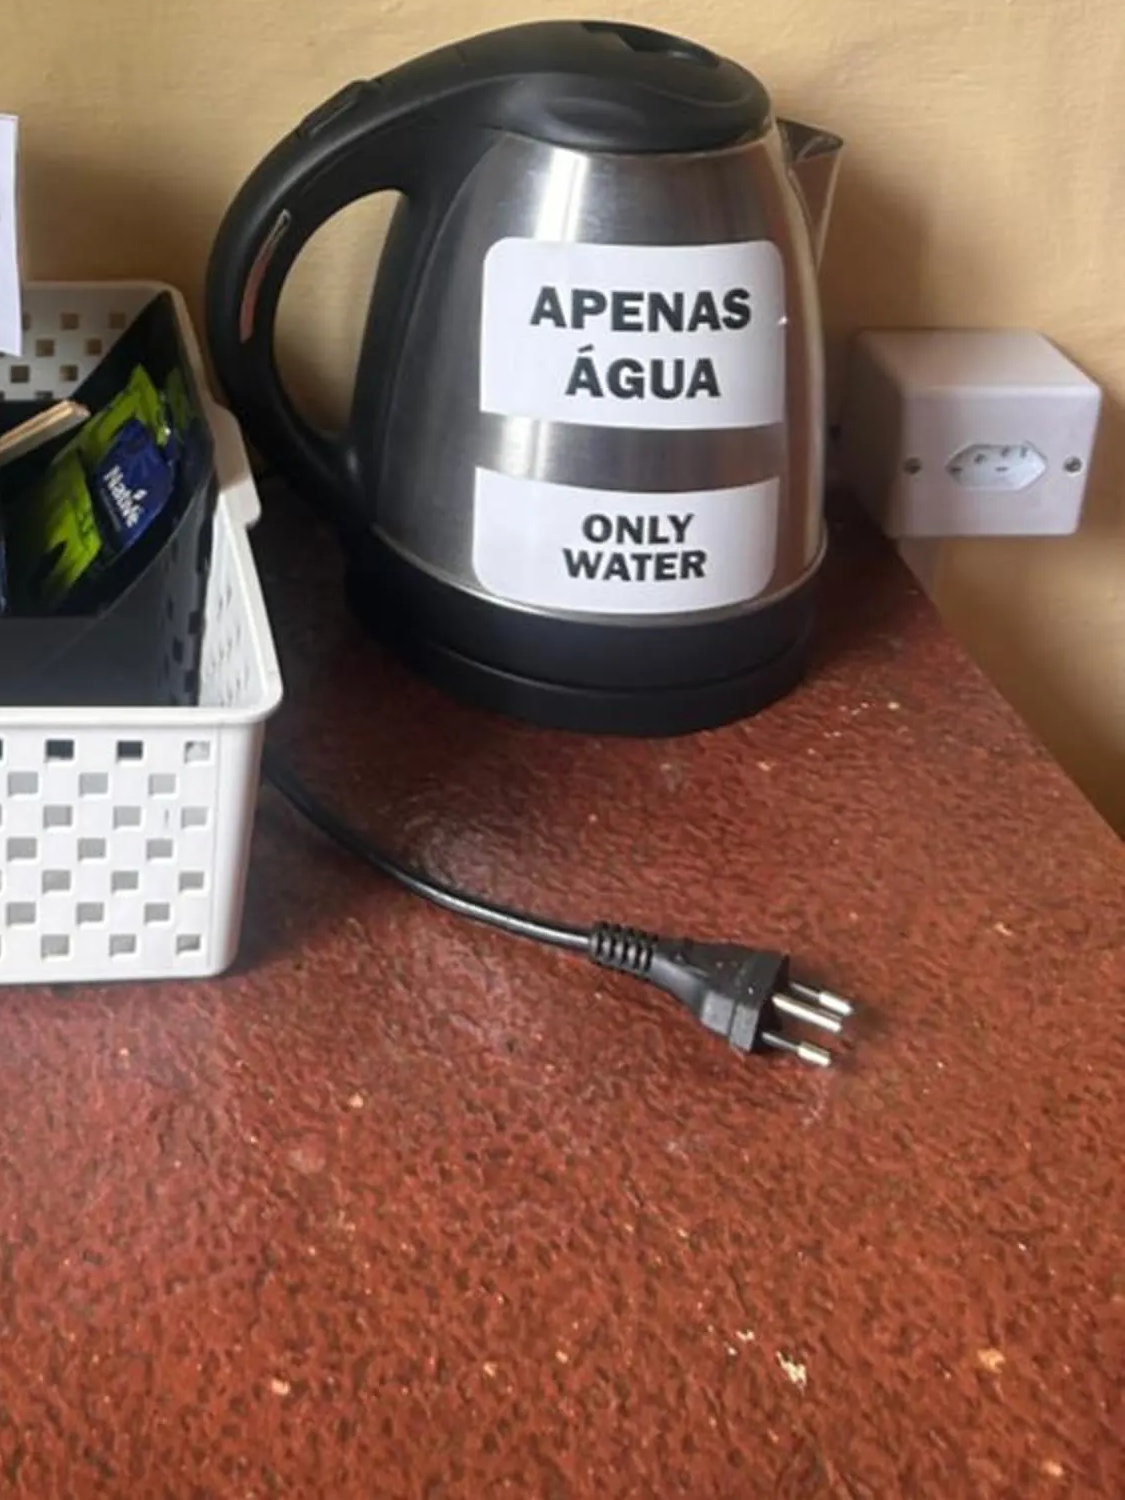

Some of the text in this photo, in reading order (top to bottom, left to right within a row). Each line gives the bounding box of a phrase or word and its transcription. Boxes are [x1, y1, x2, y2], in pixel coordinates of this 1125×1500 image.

[530, 285, 752, 332] APENAS
[565, 344, 721, 400] ÁGUA
[582, 513, 695, 545] ONLY
[562, 548, 707, 582] WATER
